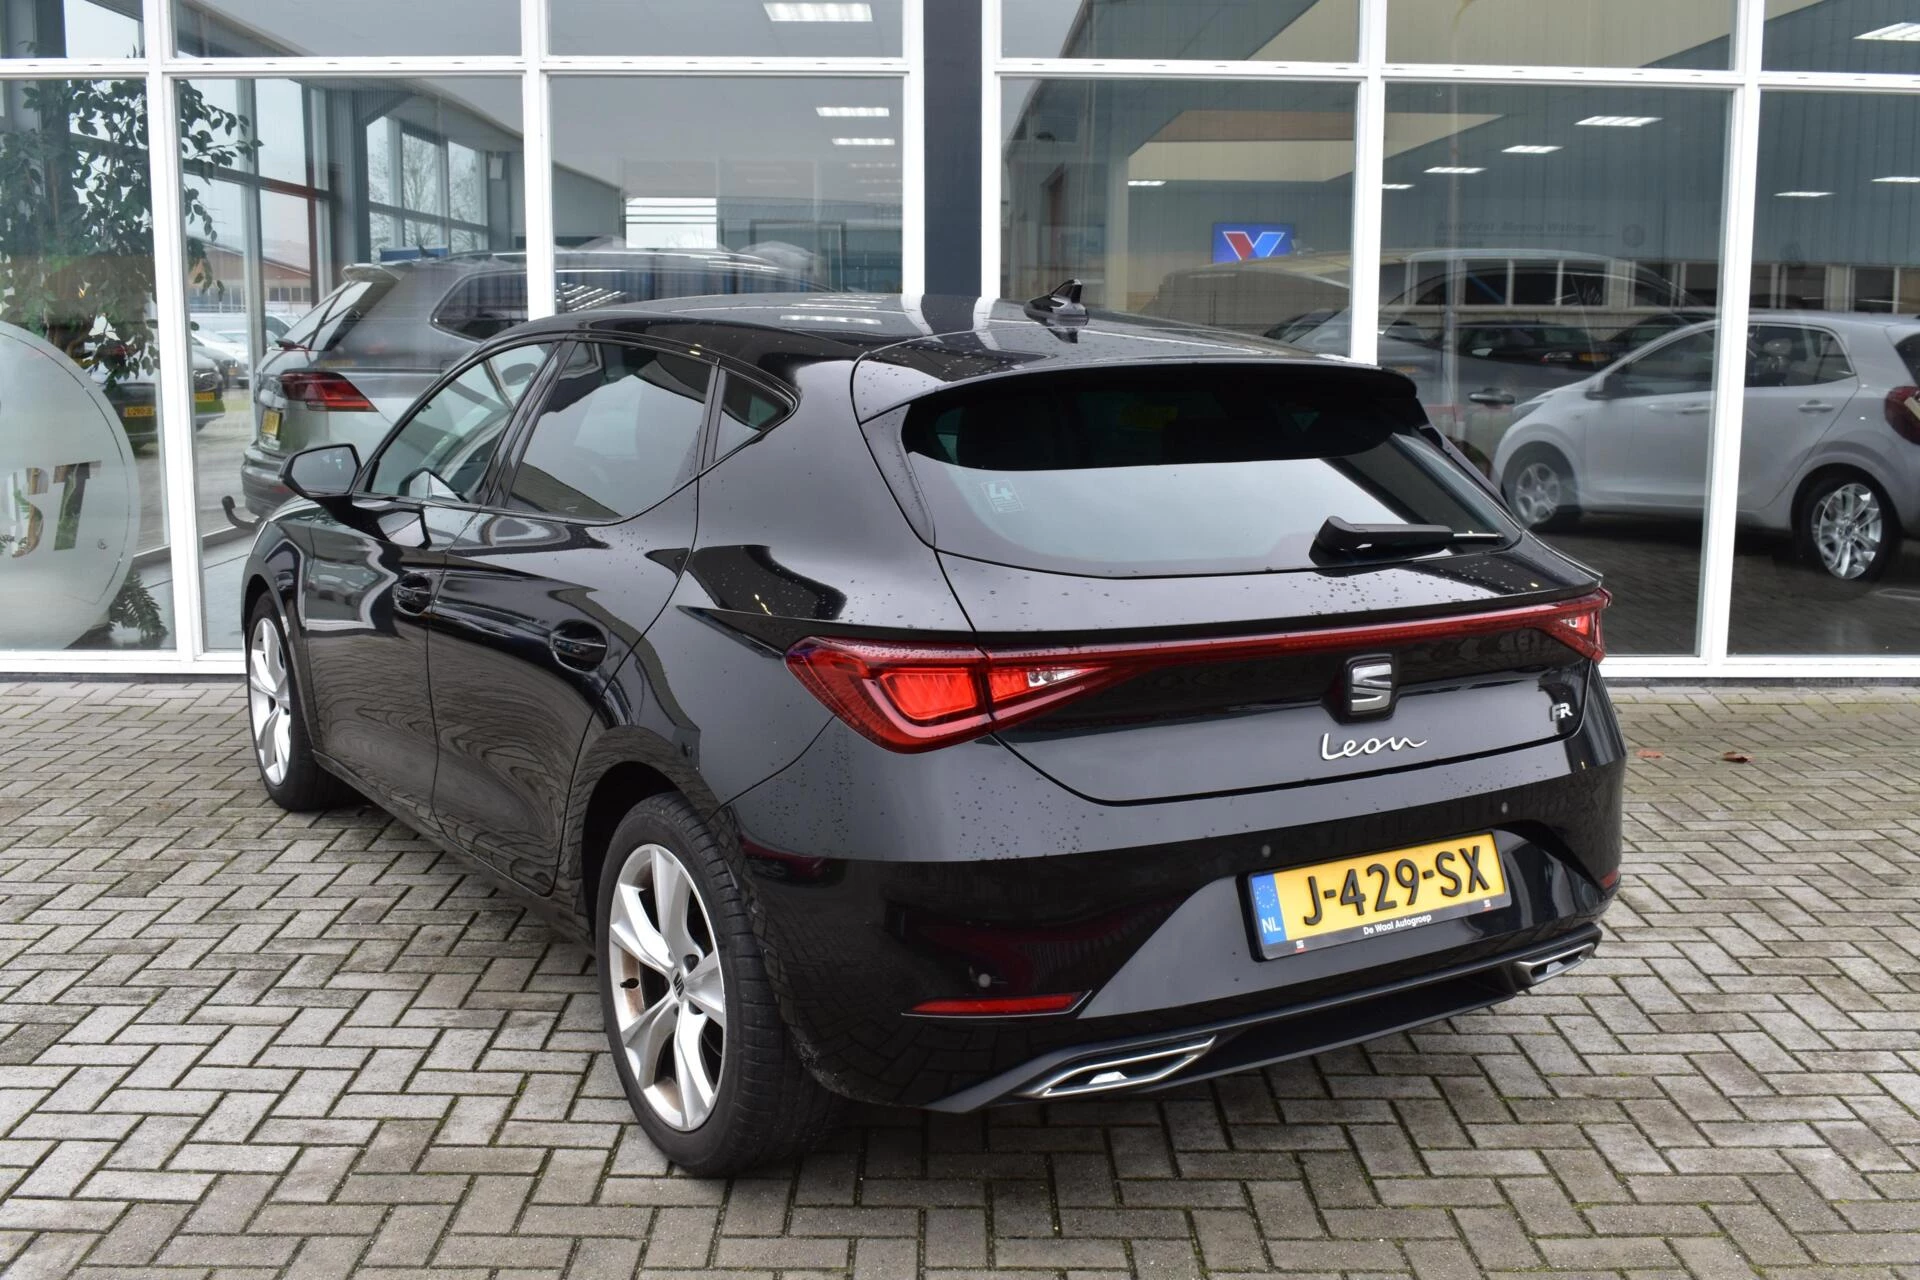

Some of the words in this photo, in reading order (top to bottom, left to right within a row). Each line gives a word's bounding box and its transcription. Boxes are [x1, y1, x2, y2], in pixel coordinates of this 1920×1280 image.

[1550, 702, 1573, 721] FR
[1321, 733, 1428, 760] Leon
[1303, 845, 1490, 926] J-429-SX
[1261, 916, 1281, 934] NL
[1363, 926, 1374, 935] De
[1374, 921, 1394, 933] Waal
[1395, 914, 1432, 929] Autogroep
